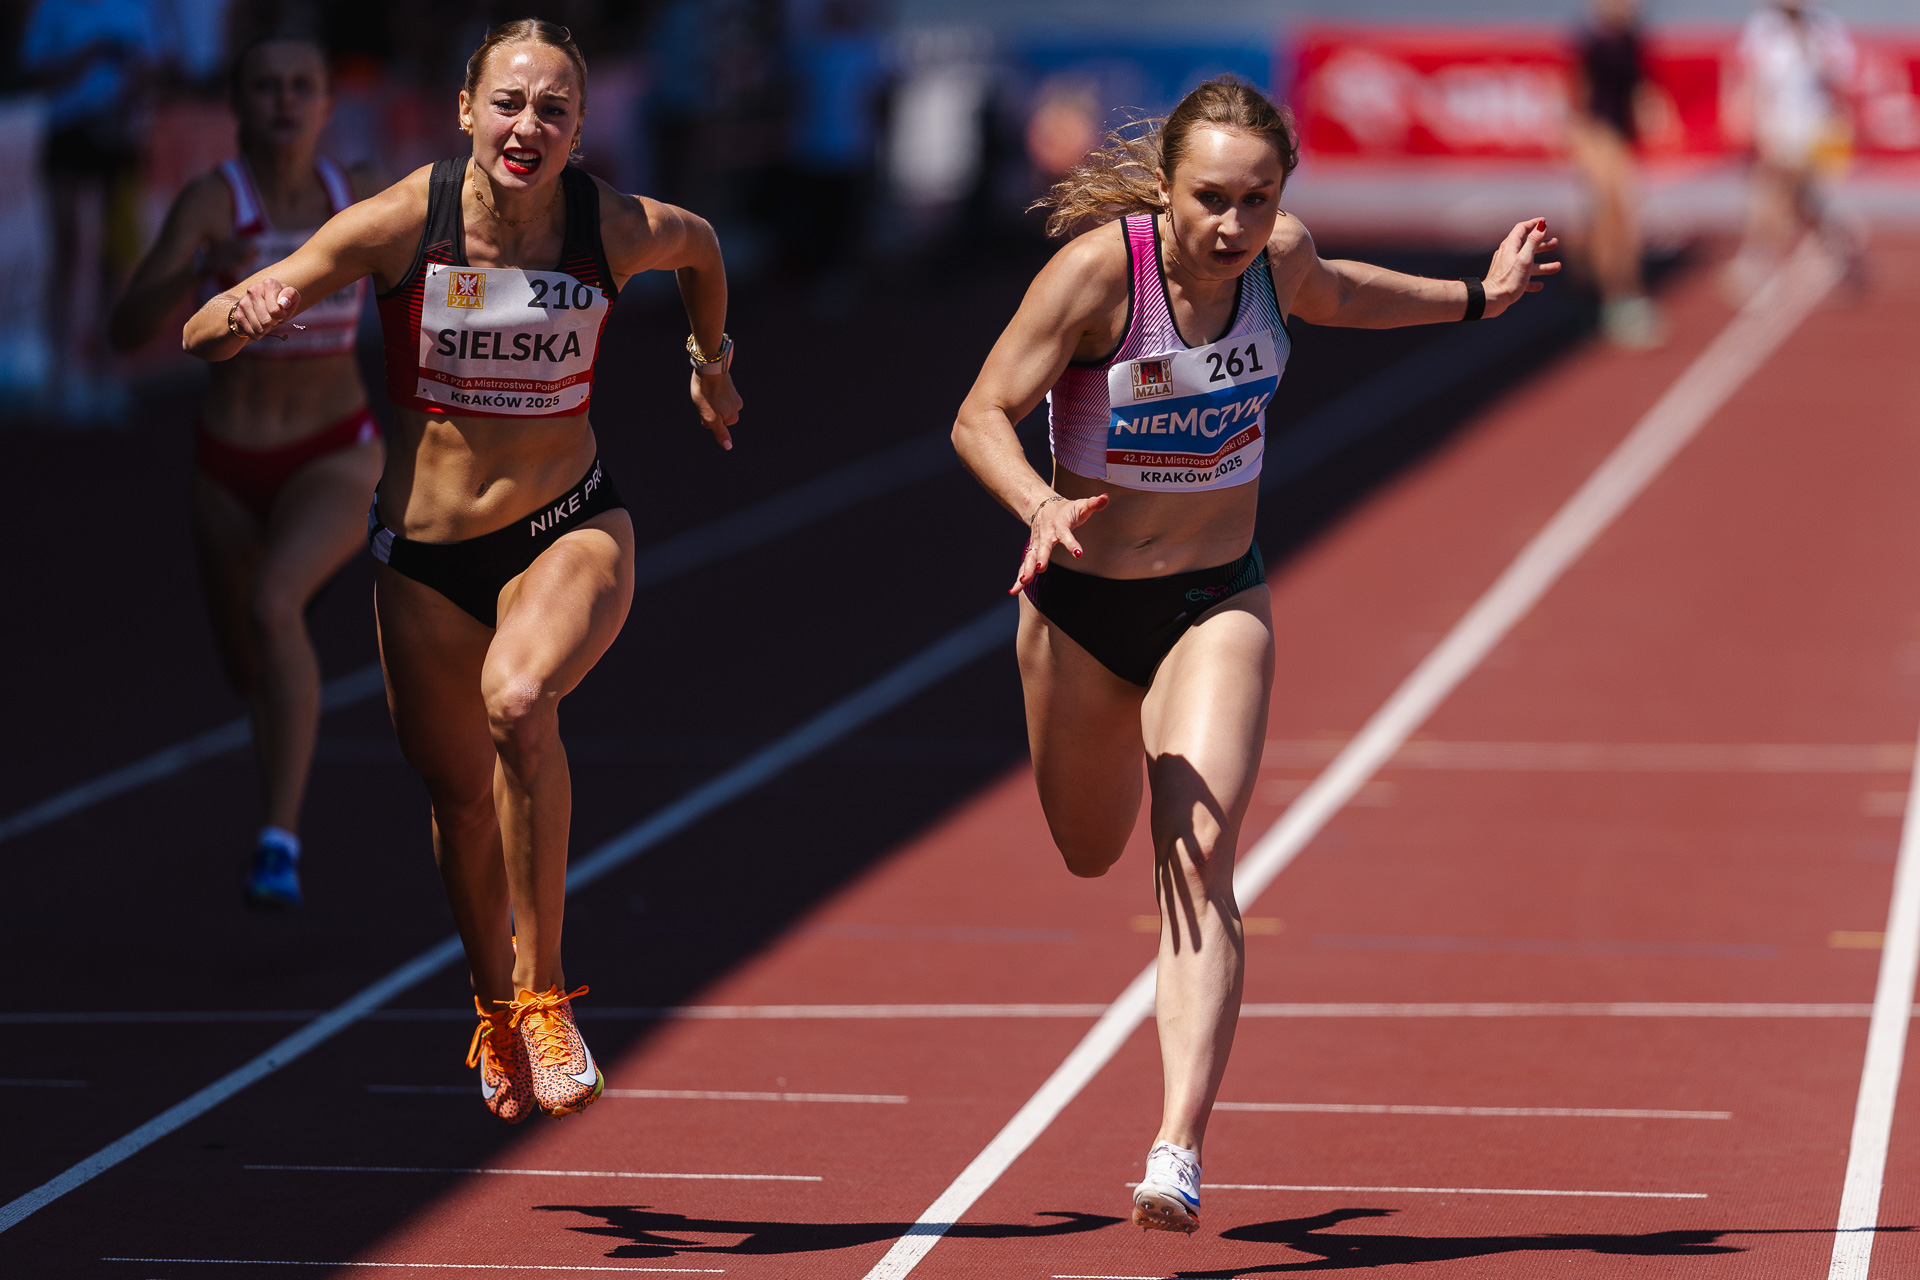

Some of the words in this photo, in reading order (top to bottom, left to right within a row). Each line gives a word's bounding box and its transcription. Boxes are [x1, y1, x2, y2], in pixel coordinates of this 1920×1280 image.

[449, 296, 482, 308] PZLA
[527, 279, 593, 310] 210
[436, 328, 581, 363] SIELSKA
[1205, 343, 1263, 383] 261
[435, 372, 449, 384] 42.
[450, 377, 473, 388] PZLA
[474, 379, 533, 390] Mistrzostwa
[535, 380, 562, 391] Polski
[561, 375, 576, 387] U23
[1135, 383, 1171, 398] MZLA
[450, 391, 523, 408] KRAKÓW
[525, 394, 560, 408] 2025
[1114, 391, 1270, 439] NIEMCZYK
[1123, 454, 1138, 464] 42.
[1140, 455, 1163, 465] PZLA
[1236, 432, 1250, 446] U23
[1140, 469, 1213, 483] KRAKÓW
[1214, 455, 1243, 479] 2025
[530, 492, 581, 537] NIKE
